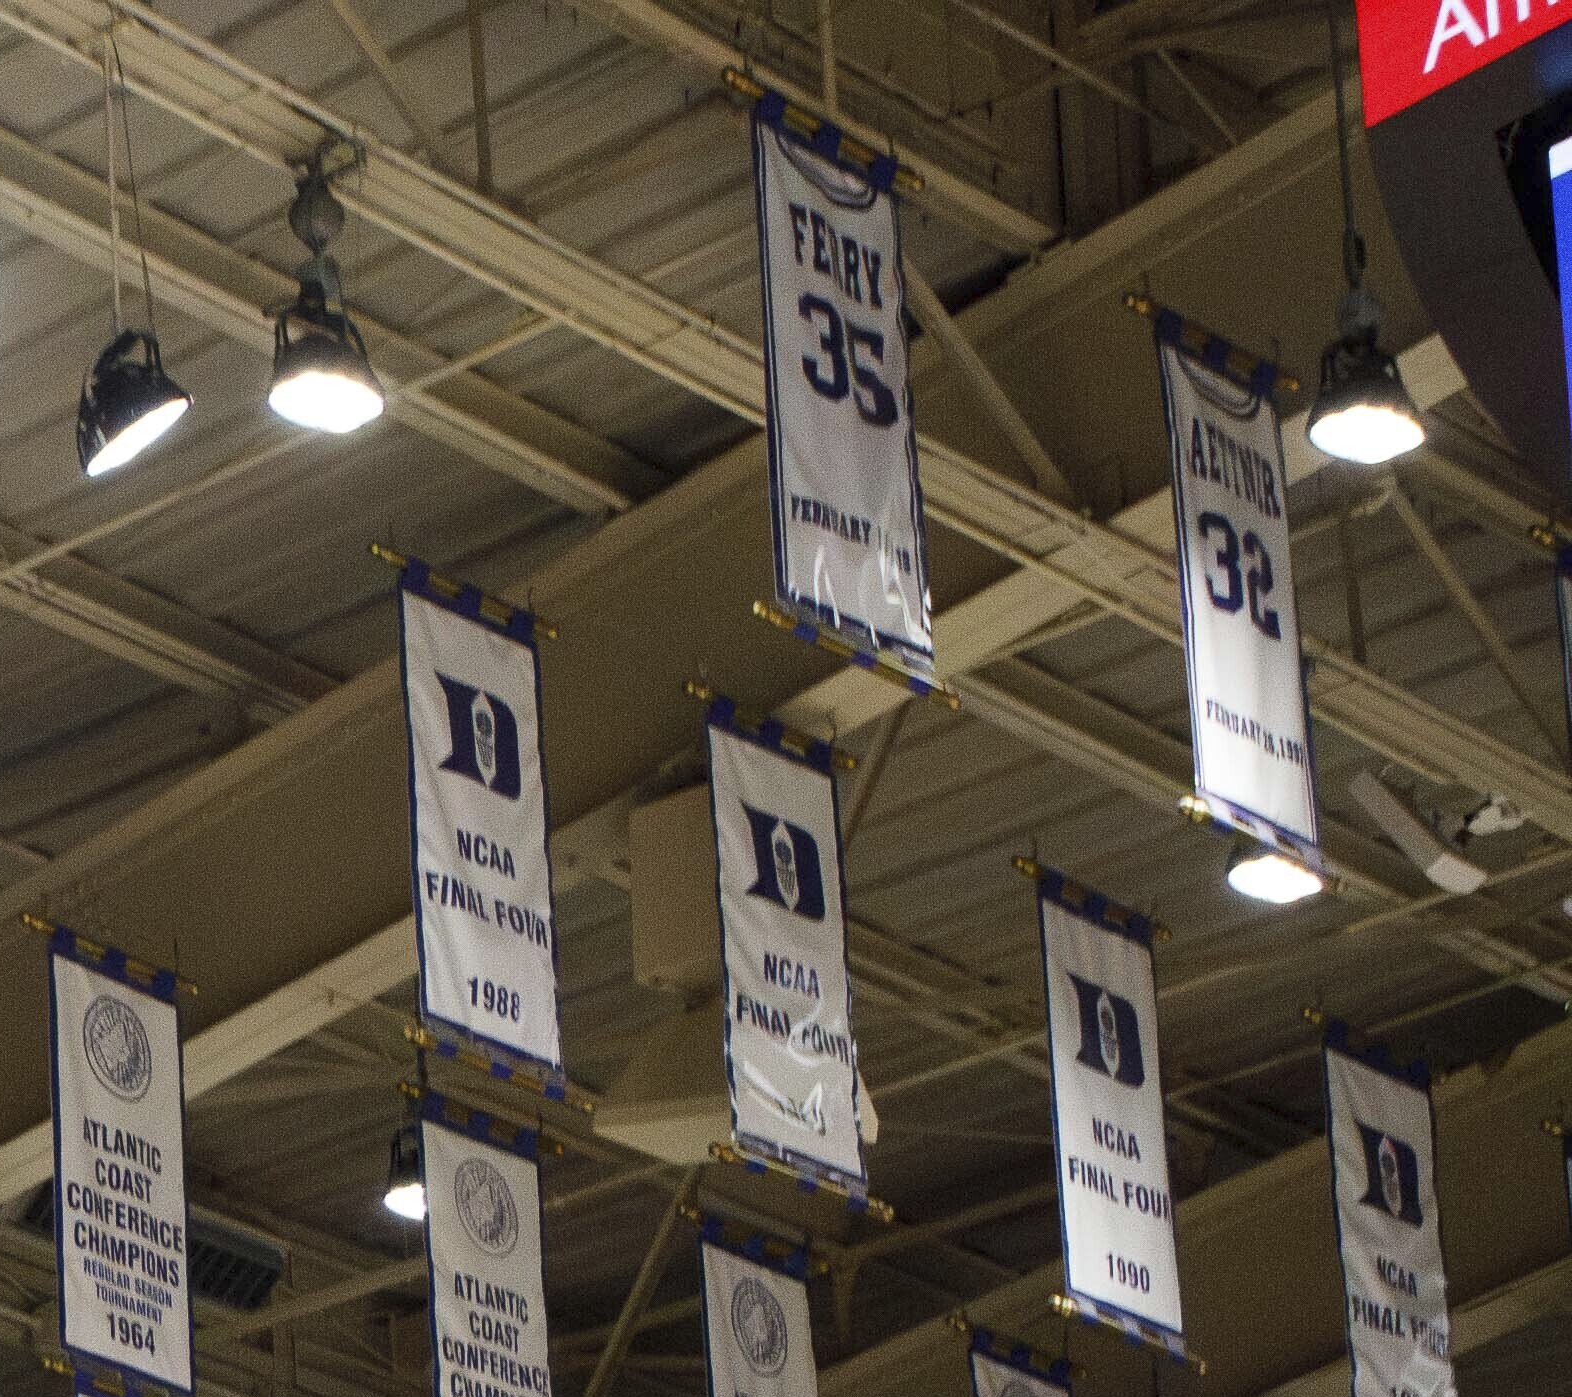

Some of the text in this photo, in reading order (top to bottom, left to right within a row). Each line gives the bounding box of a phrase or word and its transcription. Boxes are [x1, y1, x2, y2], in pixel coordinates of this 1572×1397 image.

[789, 202, 882, 307] FERRY
[798, 291, 899, 427] 35
[1198, 511, 1281, 641] 32
[456, 827, 516, 880] NCAA
[425, 870, 549, 950] FINAL FOUR
[467, 976, 520, 1023] 1988
[763, 952, 820, 998] NCAA
[84, 1116, 161, 1174] ATLANTIC
[1092, 1116, 1141, 1162] NCAA
[95, 1158, 152, 1203] COAST
[1068, 1154, 1118, 1203] FINAL
[67, 1179, 183, 1252] CONFERENCE
[74, 1220, 179, 1287] CHAMPIONS
[1107, 1251, 1150, 1295] 1990
[95, 1282, 163, 1324] TOURNAMENT
[454, 1271, 528, 1324] ATLANTIC
[1354, 1294, 1405, 1338] FINAL
[107, 1312, 155, 1356] 1964
[469, 1310, 520, 1353] COAST
[442, 1335, 550, 1397] CONFERENCE
